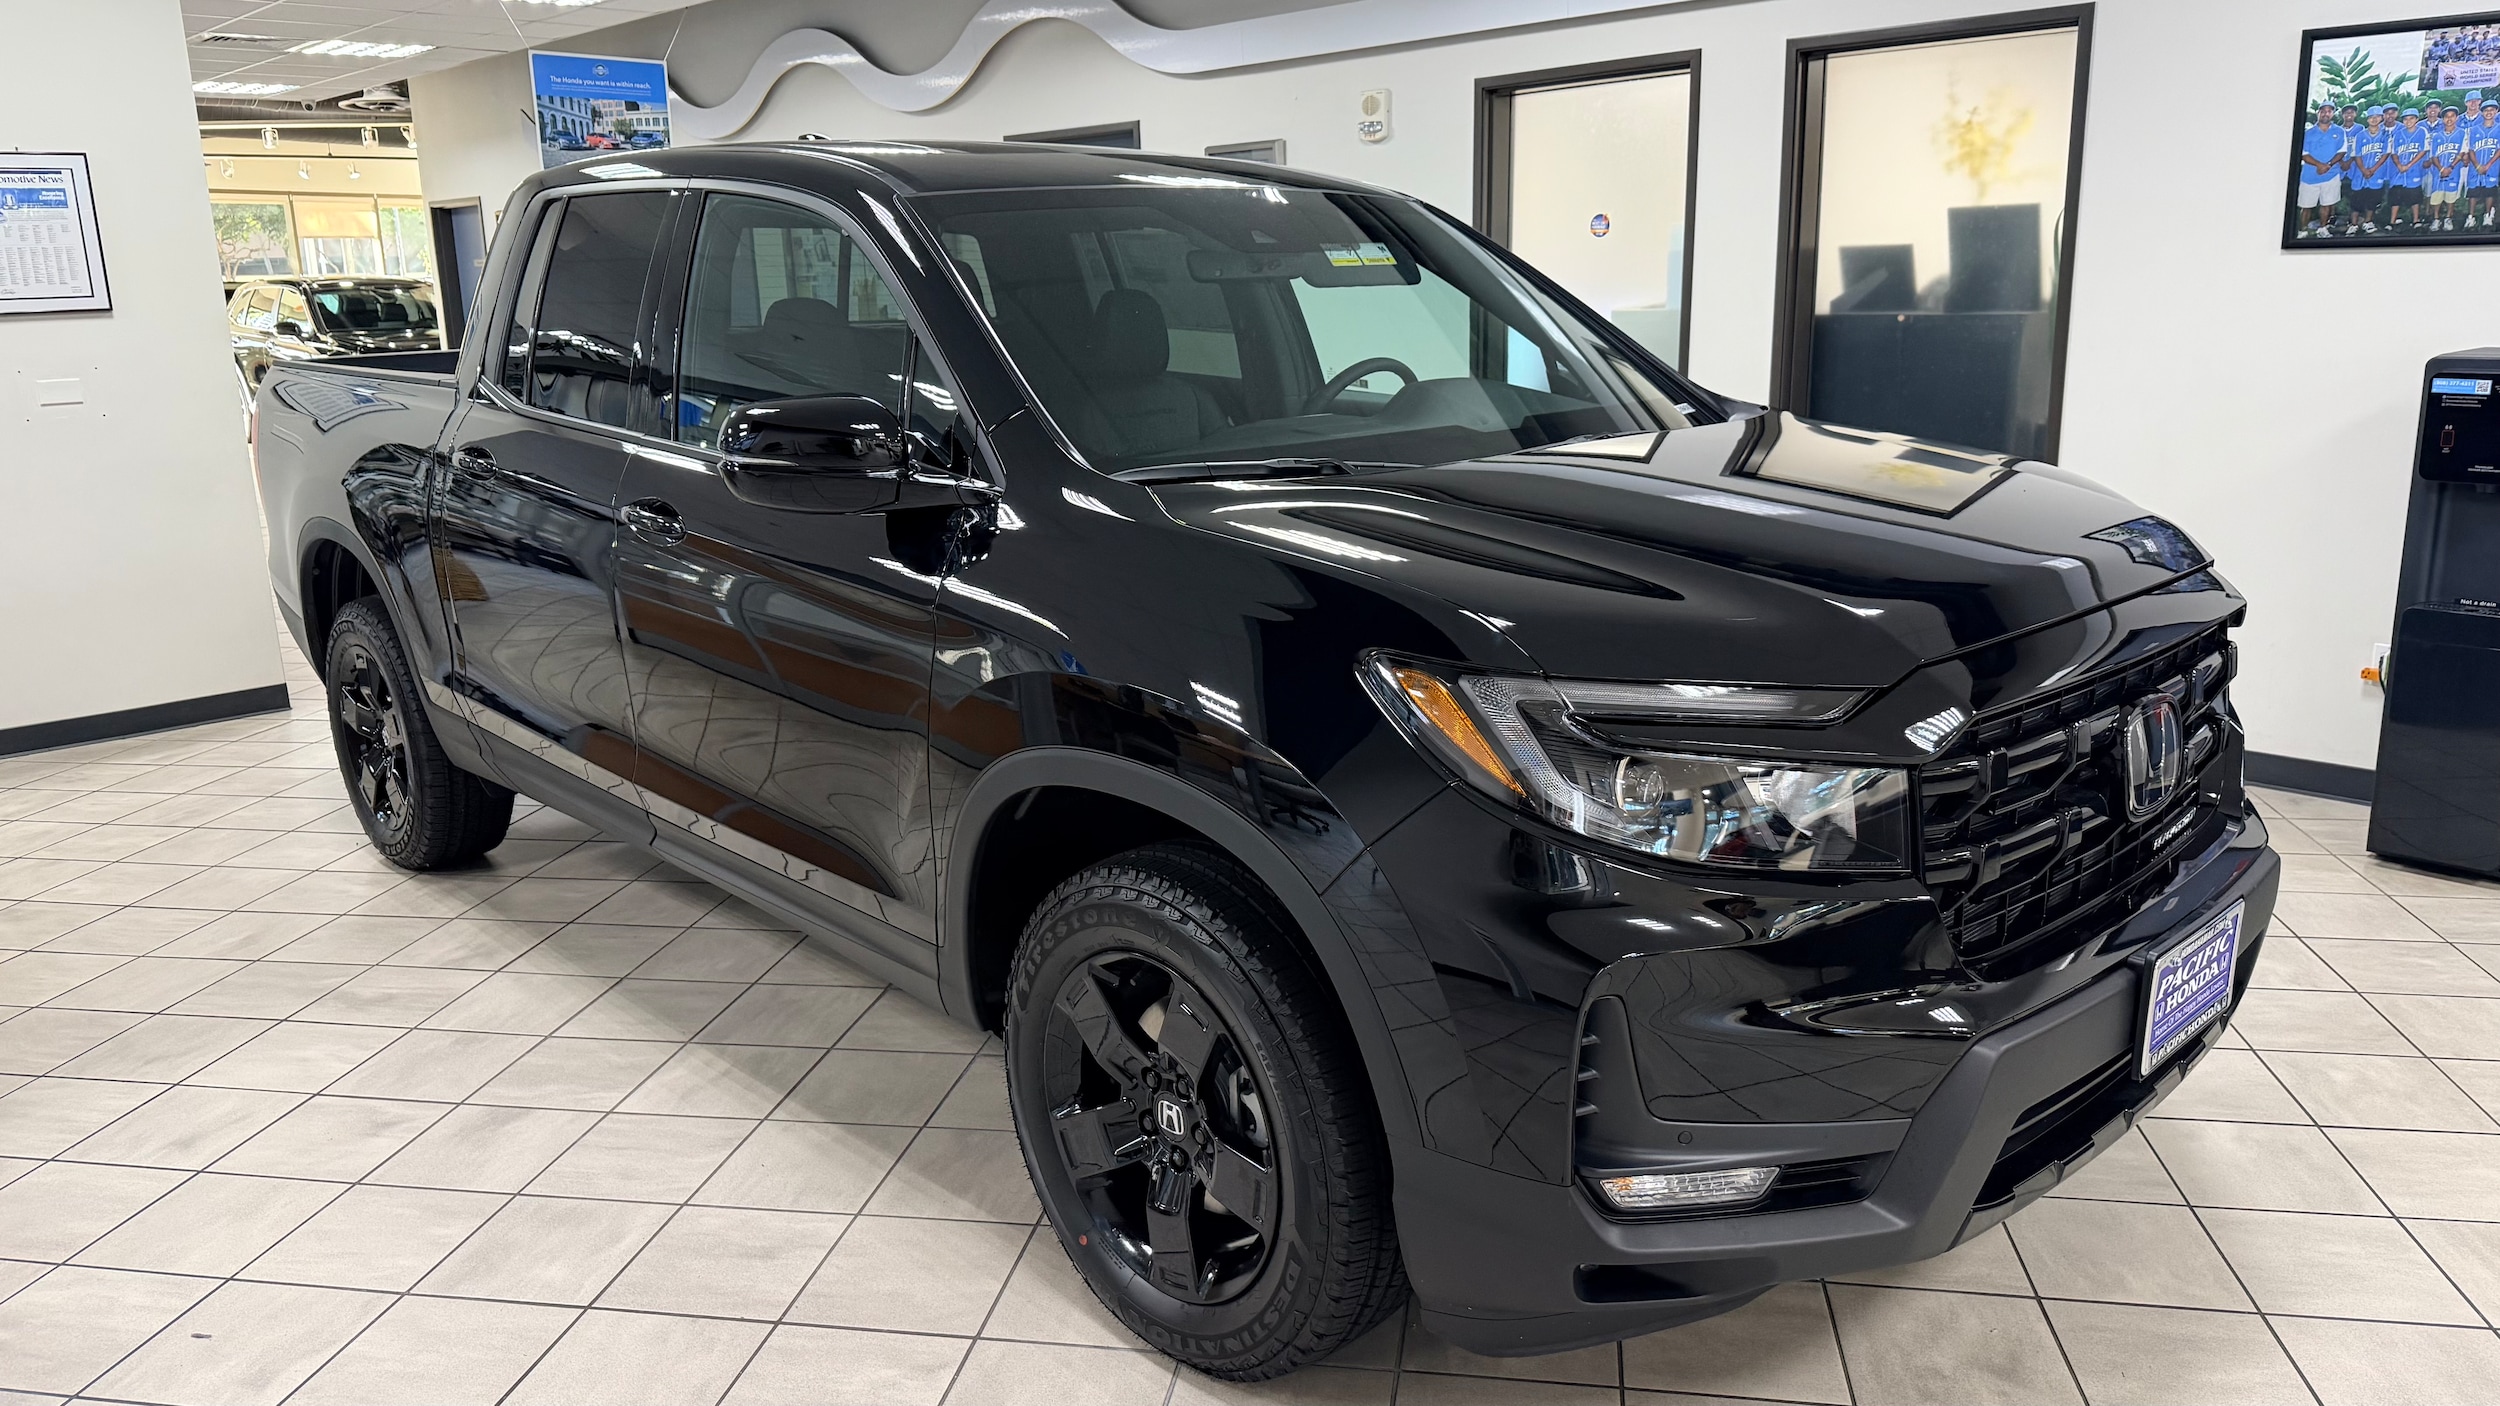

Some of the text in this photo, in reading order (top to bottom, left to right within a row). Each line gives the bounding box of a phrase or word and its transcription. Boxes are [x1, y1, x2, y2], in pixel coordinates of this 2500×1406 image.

[550, 75, 561, 83] The
[562, 76, 582, 84] Honda
[583, 79, 595, 87] you
[38, 175, 64, 184] News
[2155, 928, 2234, 1001] PACIFIC
[2164, 960, 2220, 1014] HONDA
[1127, 1258, 1302, 1356] DESTINATION
